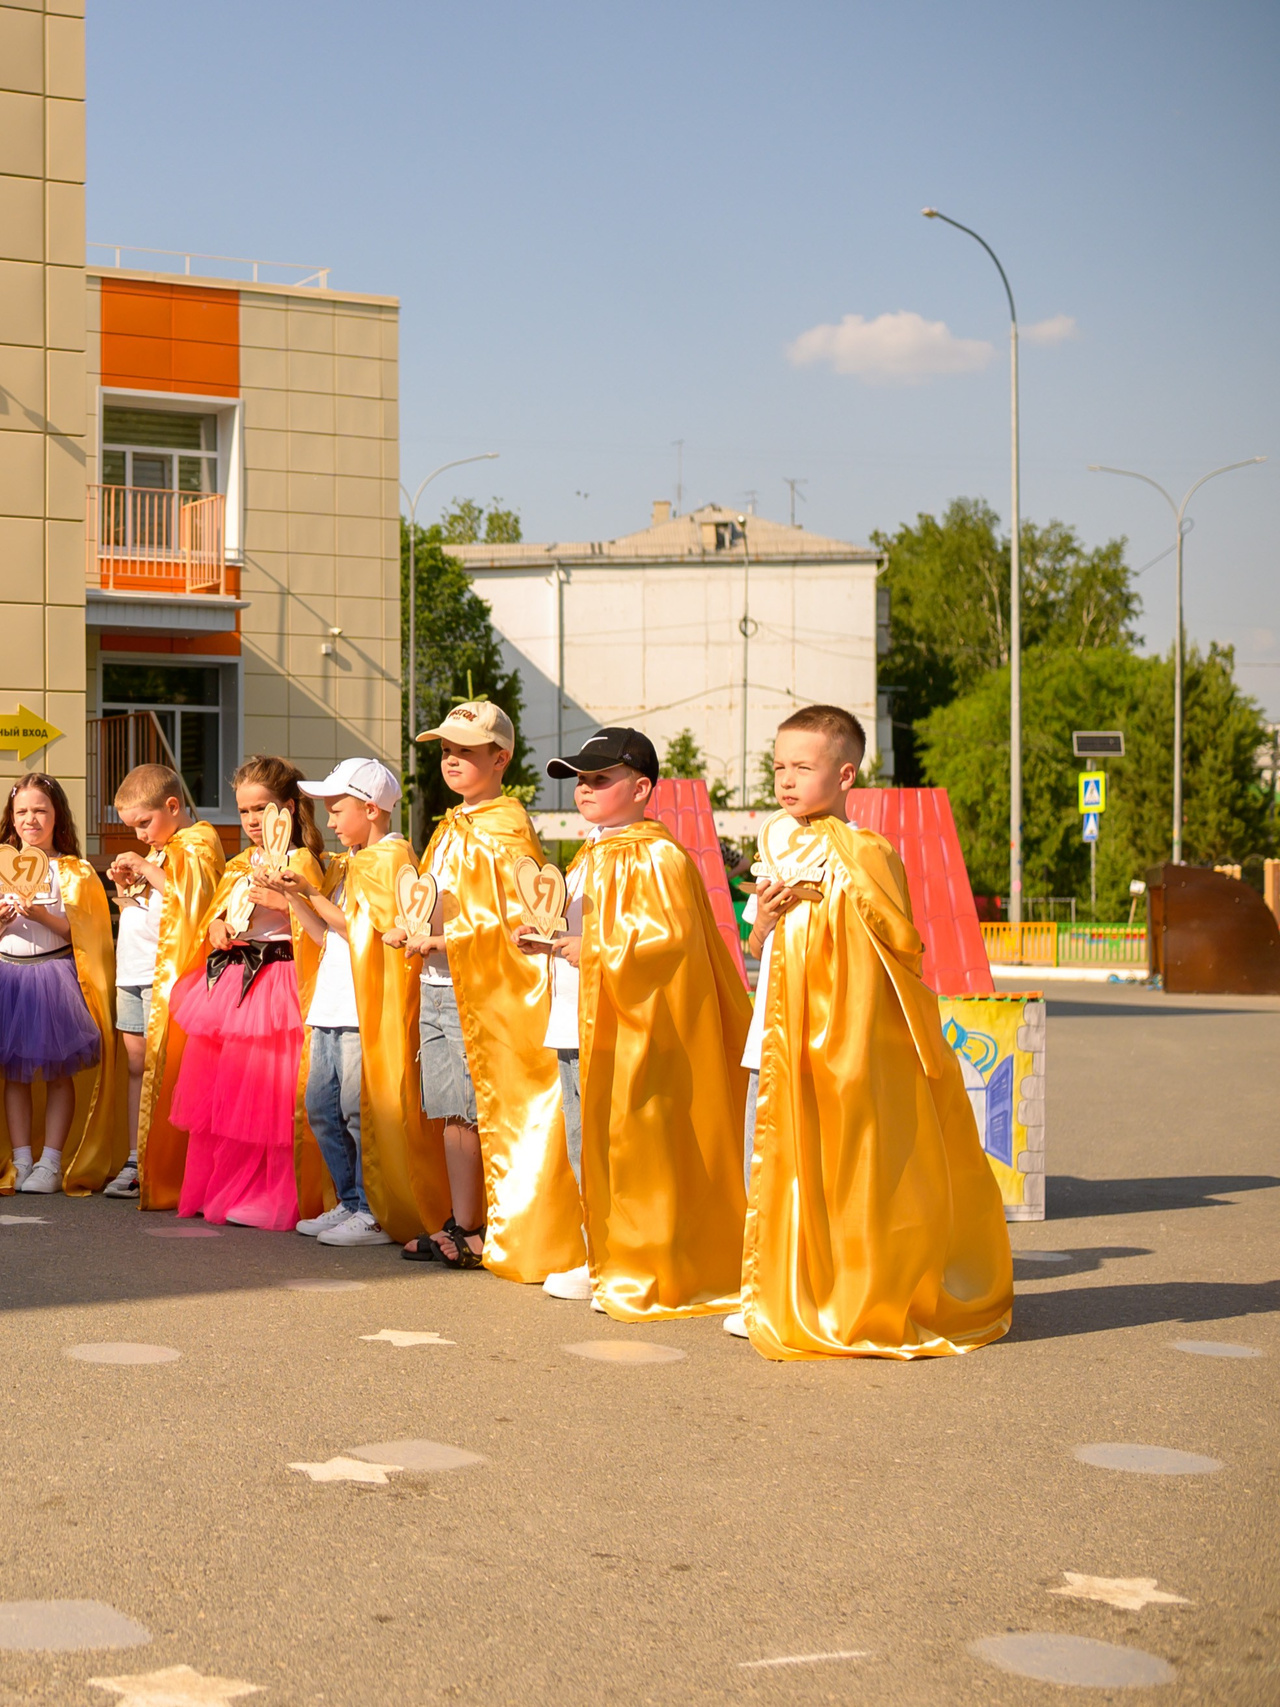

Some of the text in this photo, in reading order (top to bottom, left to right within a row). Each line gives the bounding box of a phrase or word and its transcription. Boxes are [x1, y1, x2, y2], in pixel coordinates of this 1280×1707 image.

[22, 728, 48, 738] ВХОД
[270, 817, 286, 852] Я
[11, 855, 38, 882] Я
[406, 881, 429, 918] Я
[531, 873, 556, 913] Я
